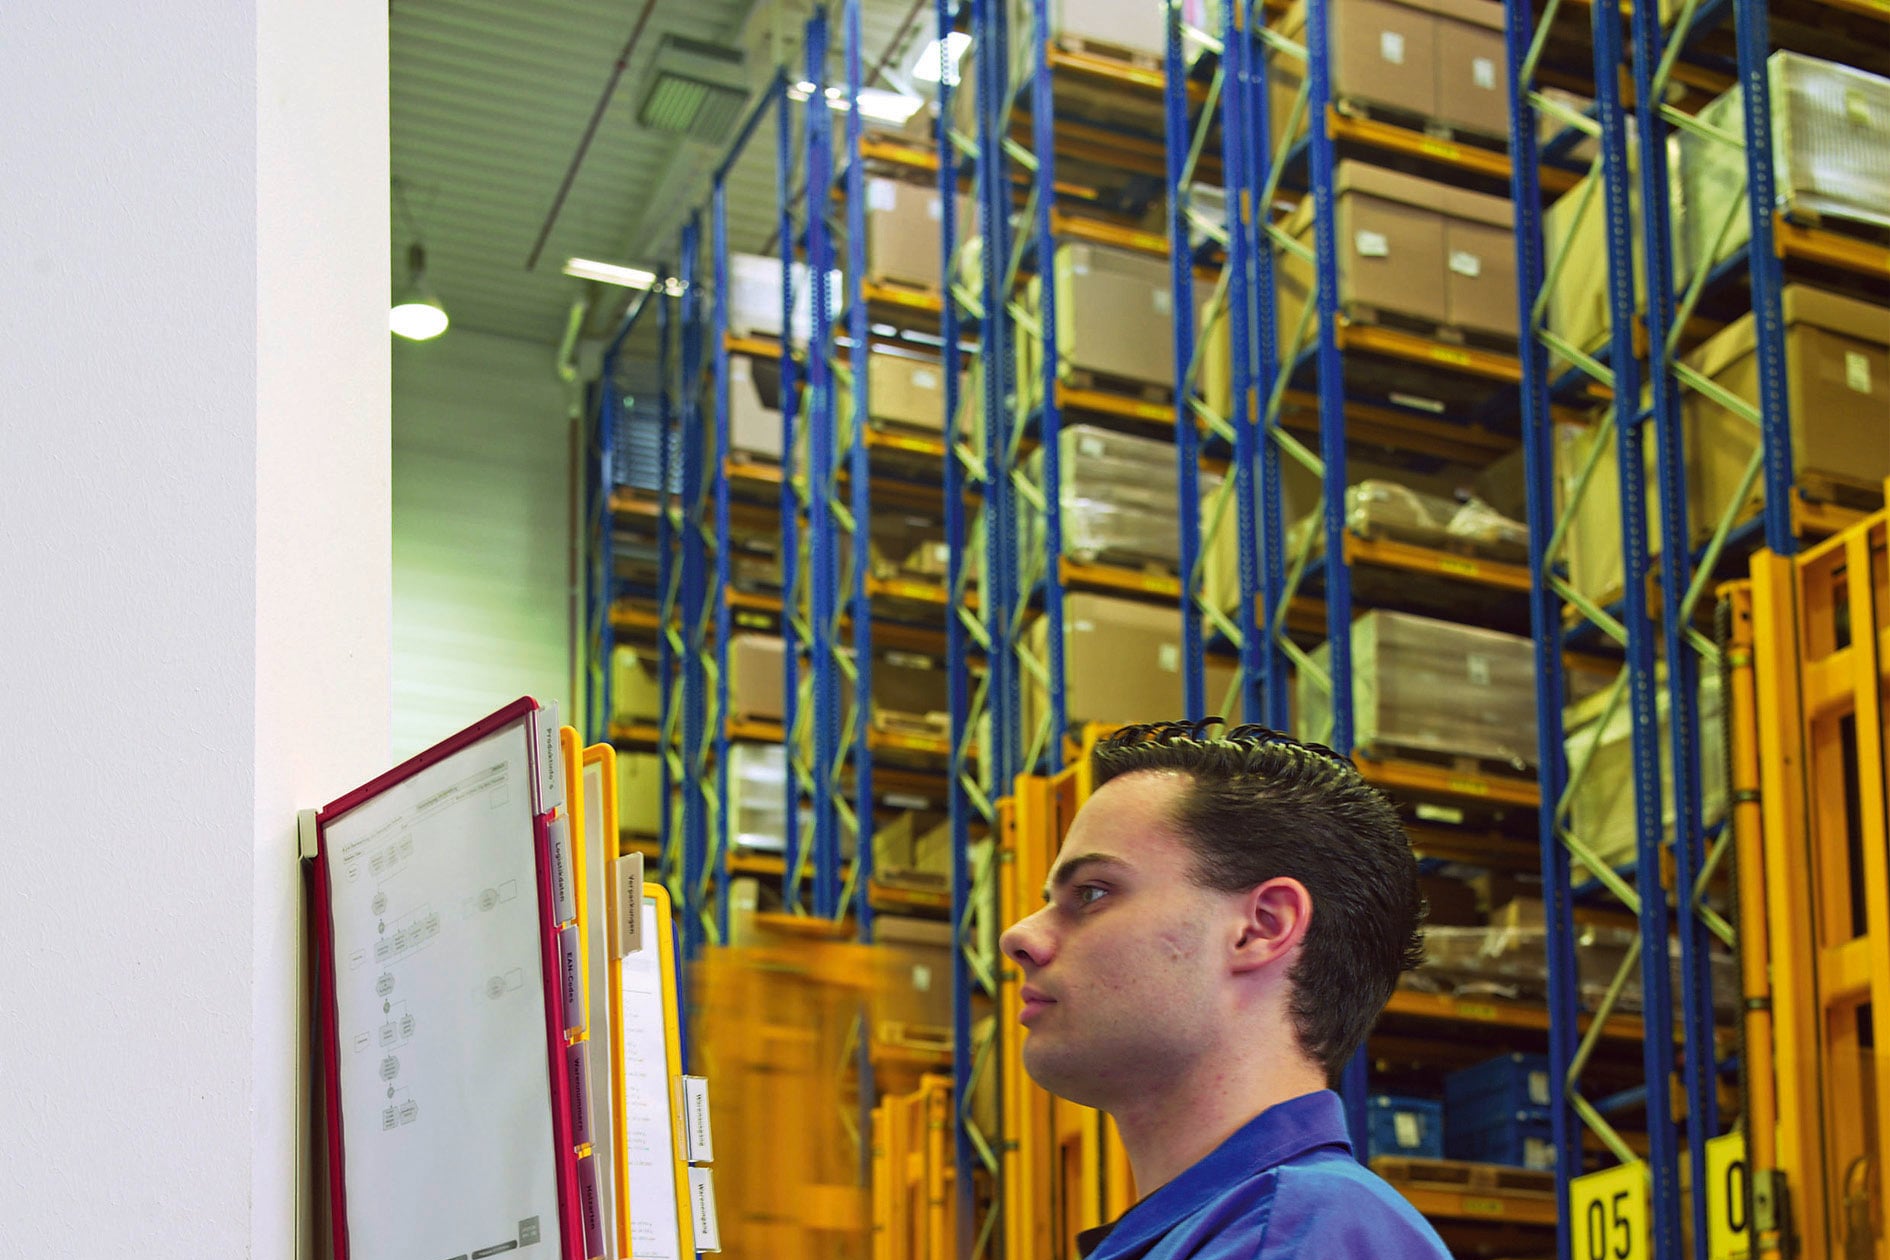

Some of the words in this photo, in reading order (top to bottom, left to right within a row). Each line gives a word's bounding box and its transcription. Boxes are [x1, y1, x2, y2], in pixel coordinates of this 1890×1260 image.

[555, 842, 565, 902] Logistikdaten
[627, 874, 635, 935] Verpackungen
[574, 1057, 583, 1131] Warennummern
[586, 1184, 595, 1230] Holzarten
[698, 1183, 708, 1234] Wareneingang
